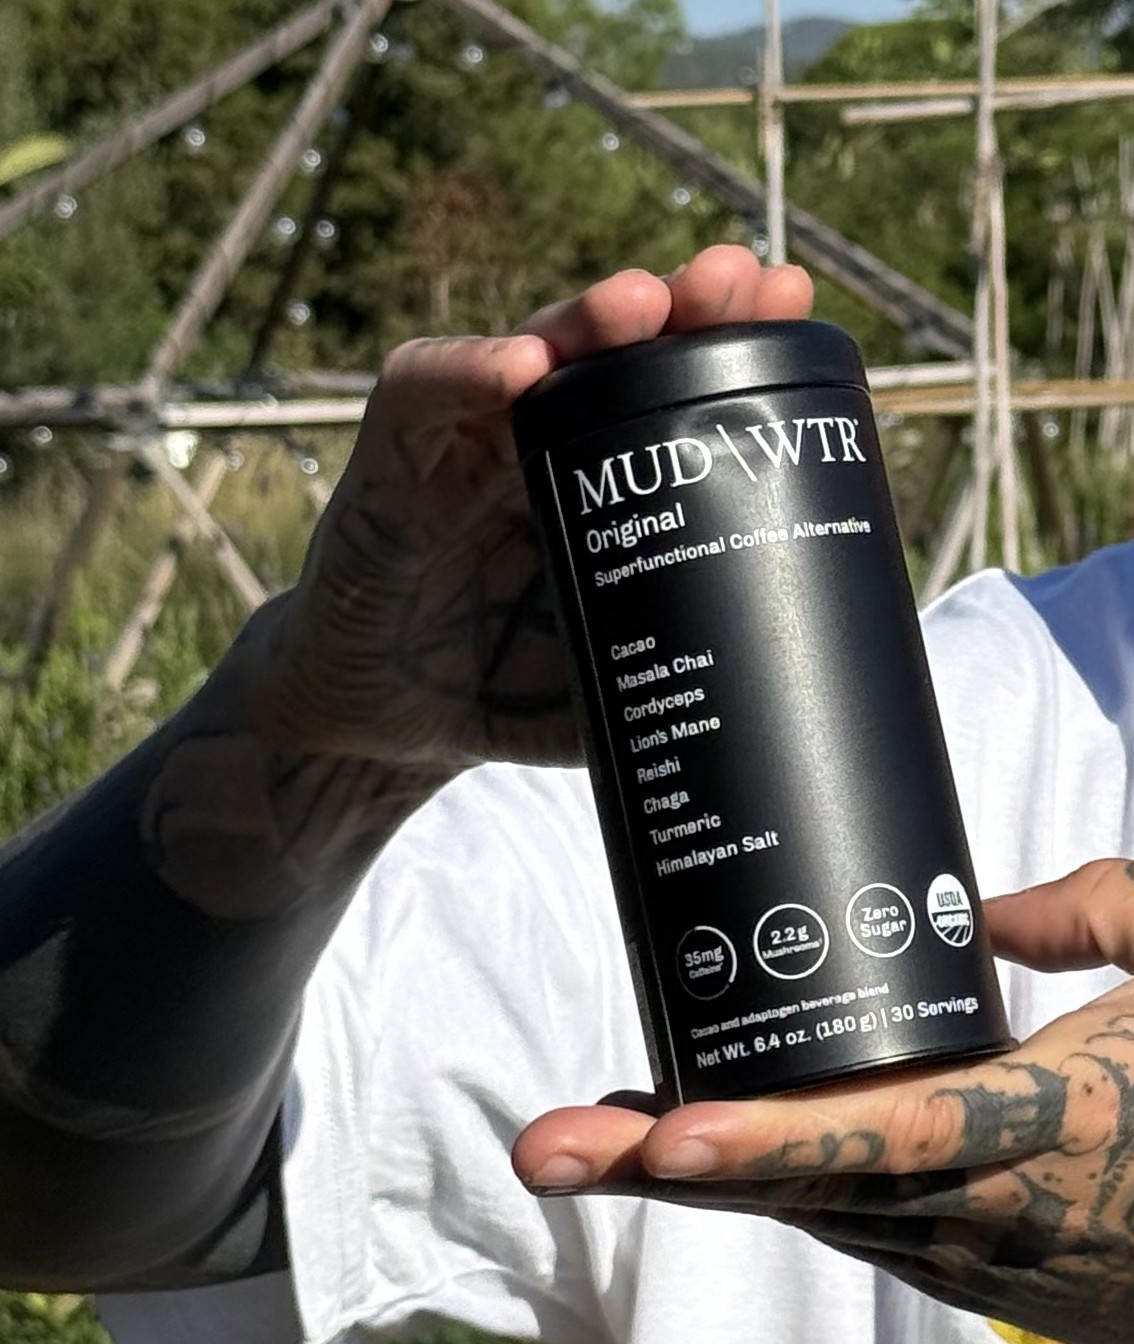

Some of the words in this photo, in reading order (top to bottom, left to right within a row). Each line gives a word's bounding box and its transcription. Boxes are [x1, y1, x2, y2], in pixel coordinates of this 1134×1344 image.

[586, 502, 685, 554] Original
[595, 537, 726, 587] Superfunctional
[730, 527, 789, 551] Coffee
[792, 517, 872, 540] Alternative
[611, 636, 656, 660] Cacao
[616, 664, 670, 692] Masala
[673, 649, 714, 674] Chai
[624, 687, 705, 722] Cordyceps
[671, 716, 721, 740] Mane
[636, 756, 682, 784] Reishi
[643, 790, 690, 814] Chaga
[649, 813, 722, 845] Turmeric
[656, 842, 738, 877] Himalayan
[742, 830, 780, 853] Salt
[861, 906, 899, 921] Zero
[936, 891, 963, 907] USDA
[860, 919, 907, 937] Sugar
[685, 945, 724, 967] 35mg
[690, 1025, 720, 1039] Cacao
[721, 1017, 740, 1031] and
[742, 1003, 800, 1028] adaptogen
[801, 991, 856, 1011] beverage
[857, 982, 890, 1000] blend
[696, 1050, 721, 1069] Net
[722, 1041, 750, 1061] Wt.
[754, 1033, 780, 1053] 6.4
[786, 1029, 811, 1045] oz.
[816, 1016, 856, 1040] (180
[860, 1012, 877, 1032] g)
[891, 1006, 914, 1023] 30
[917, 996, 979, 1019] Servings
